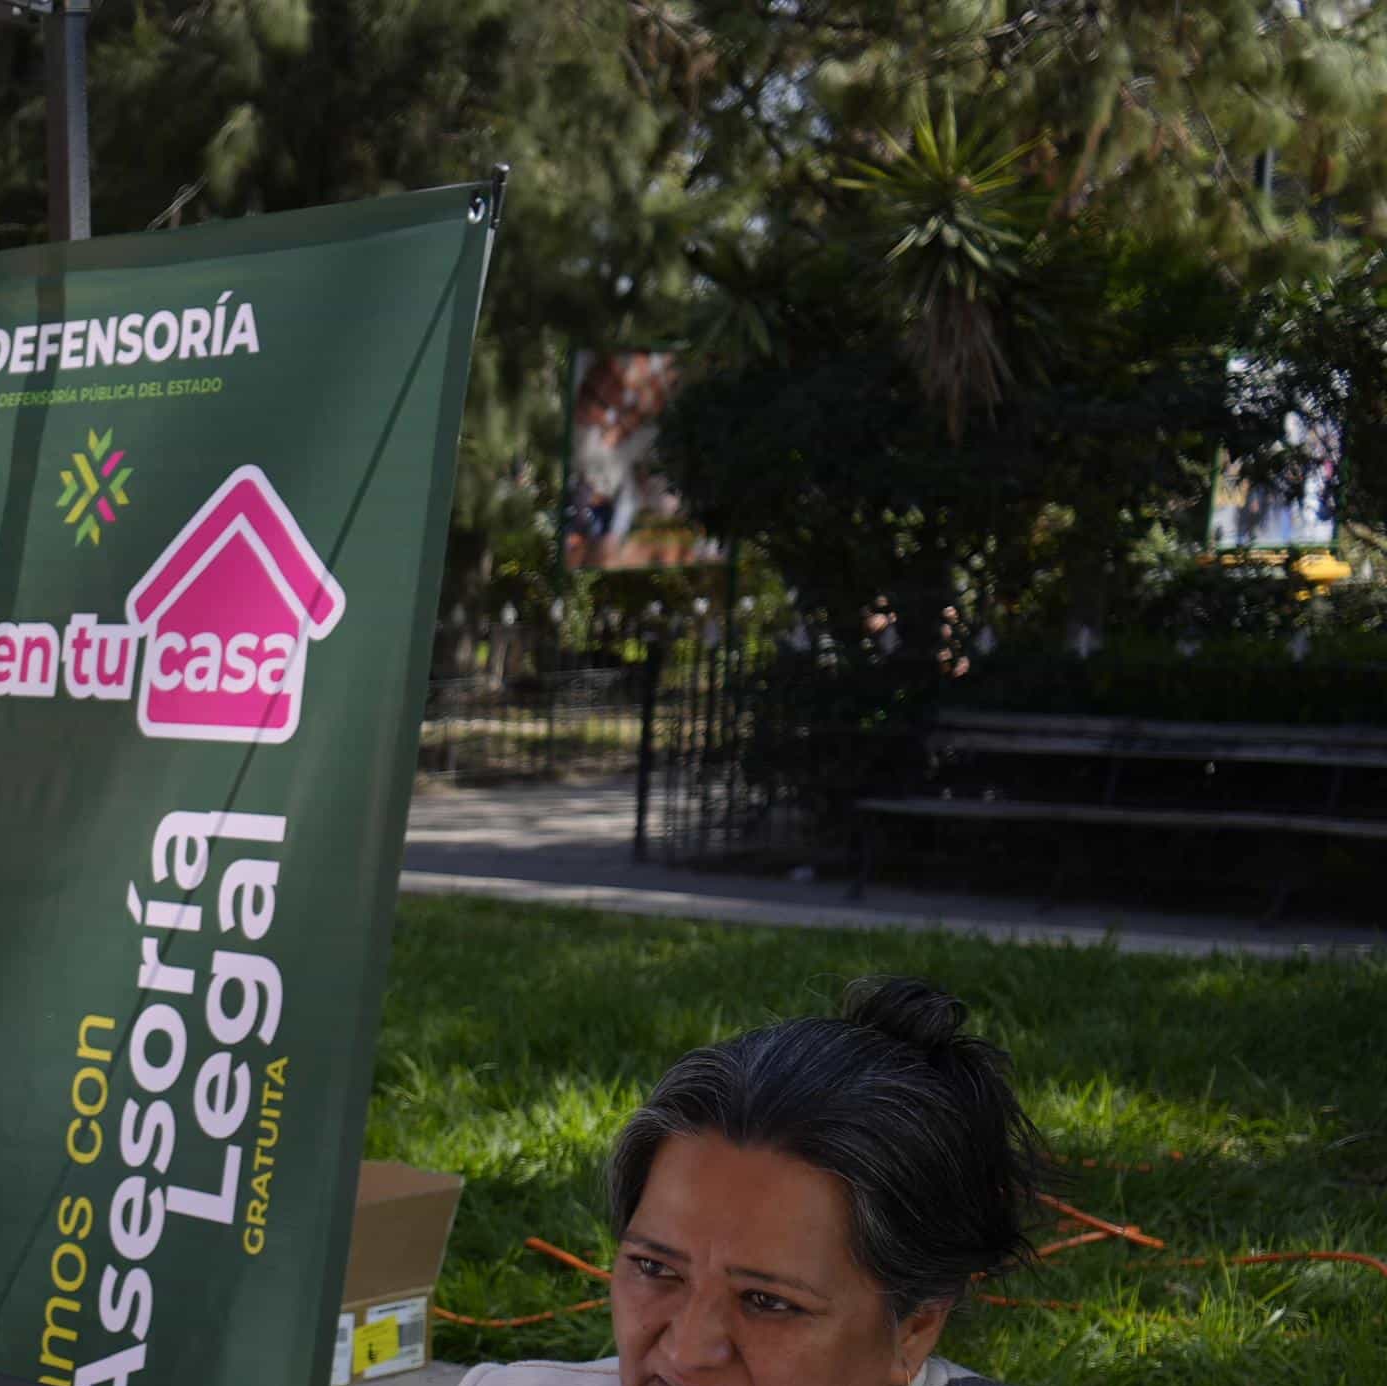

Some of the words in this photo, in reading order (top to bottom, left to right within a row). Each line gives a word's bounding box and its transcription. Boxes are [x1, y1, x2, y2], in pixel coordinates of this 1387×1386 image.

[80, 383, 135, 402] PÚBLICA
[138, 381, 165, 398] DEL
[167, 377, 223, 396] ESTADO
[70, 623, 131, 690] tu
[151, 631, 297, 695] casa
[66, 1014, 116, 1167] con
[165, 809, 287, 1225] Legal
[242, 1055, 291, 1257] GRATUITA
